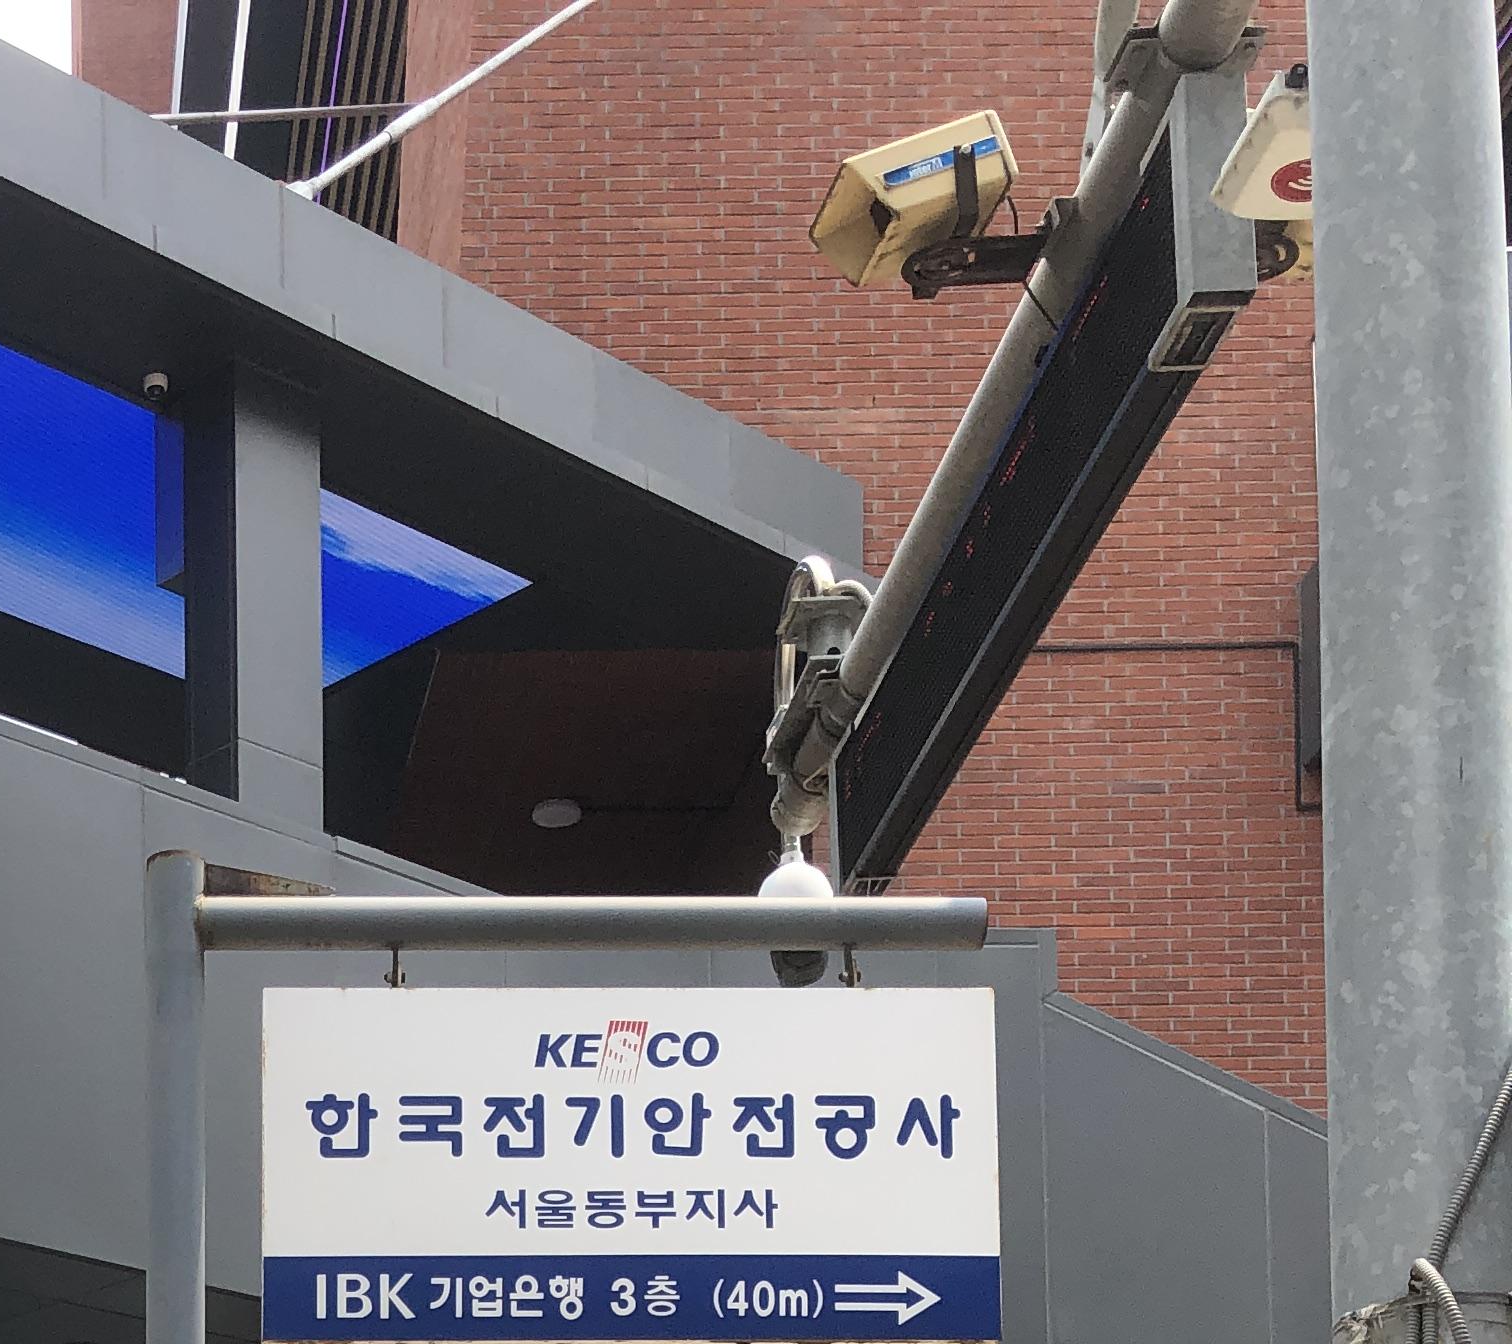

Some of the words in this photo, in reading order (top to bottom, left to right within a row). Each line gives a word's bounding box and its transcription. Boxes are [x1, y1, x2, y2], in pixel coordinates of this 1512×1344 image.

[534, 1021, 720, 1083] KESCO
[306, 1093, 961, 1159] 한국전기안전공사
[485, 1188, 779, 1230] 서울동부지사
[316, 1273, 416, 1321] IBK
[429, 1274, 585, 1322] 기업은행
[609, 1274, 680, 1319] 3층
[713, 1277, 823, 1321] (40m)
